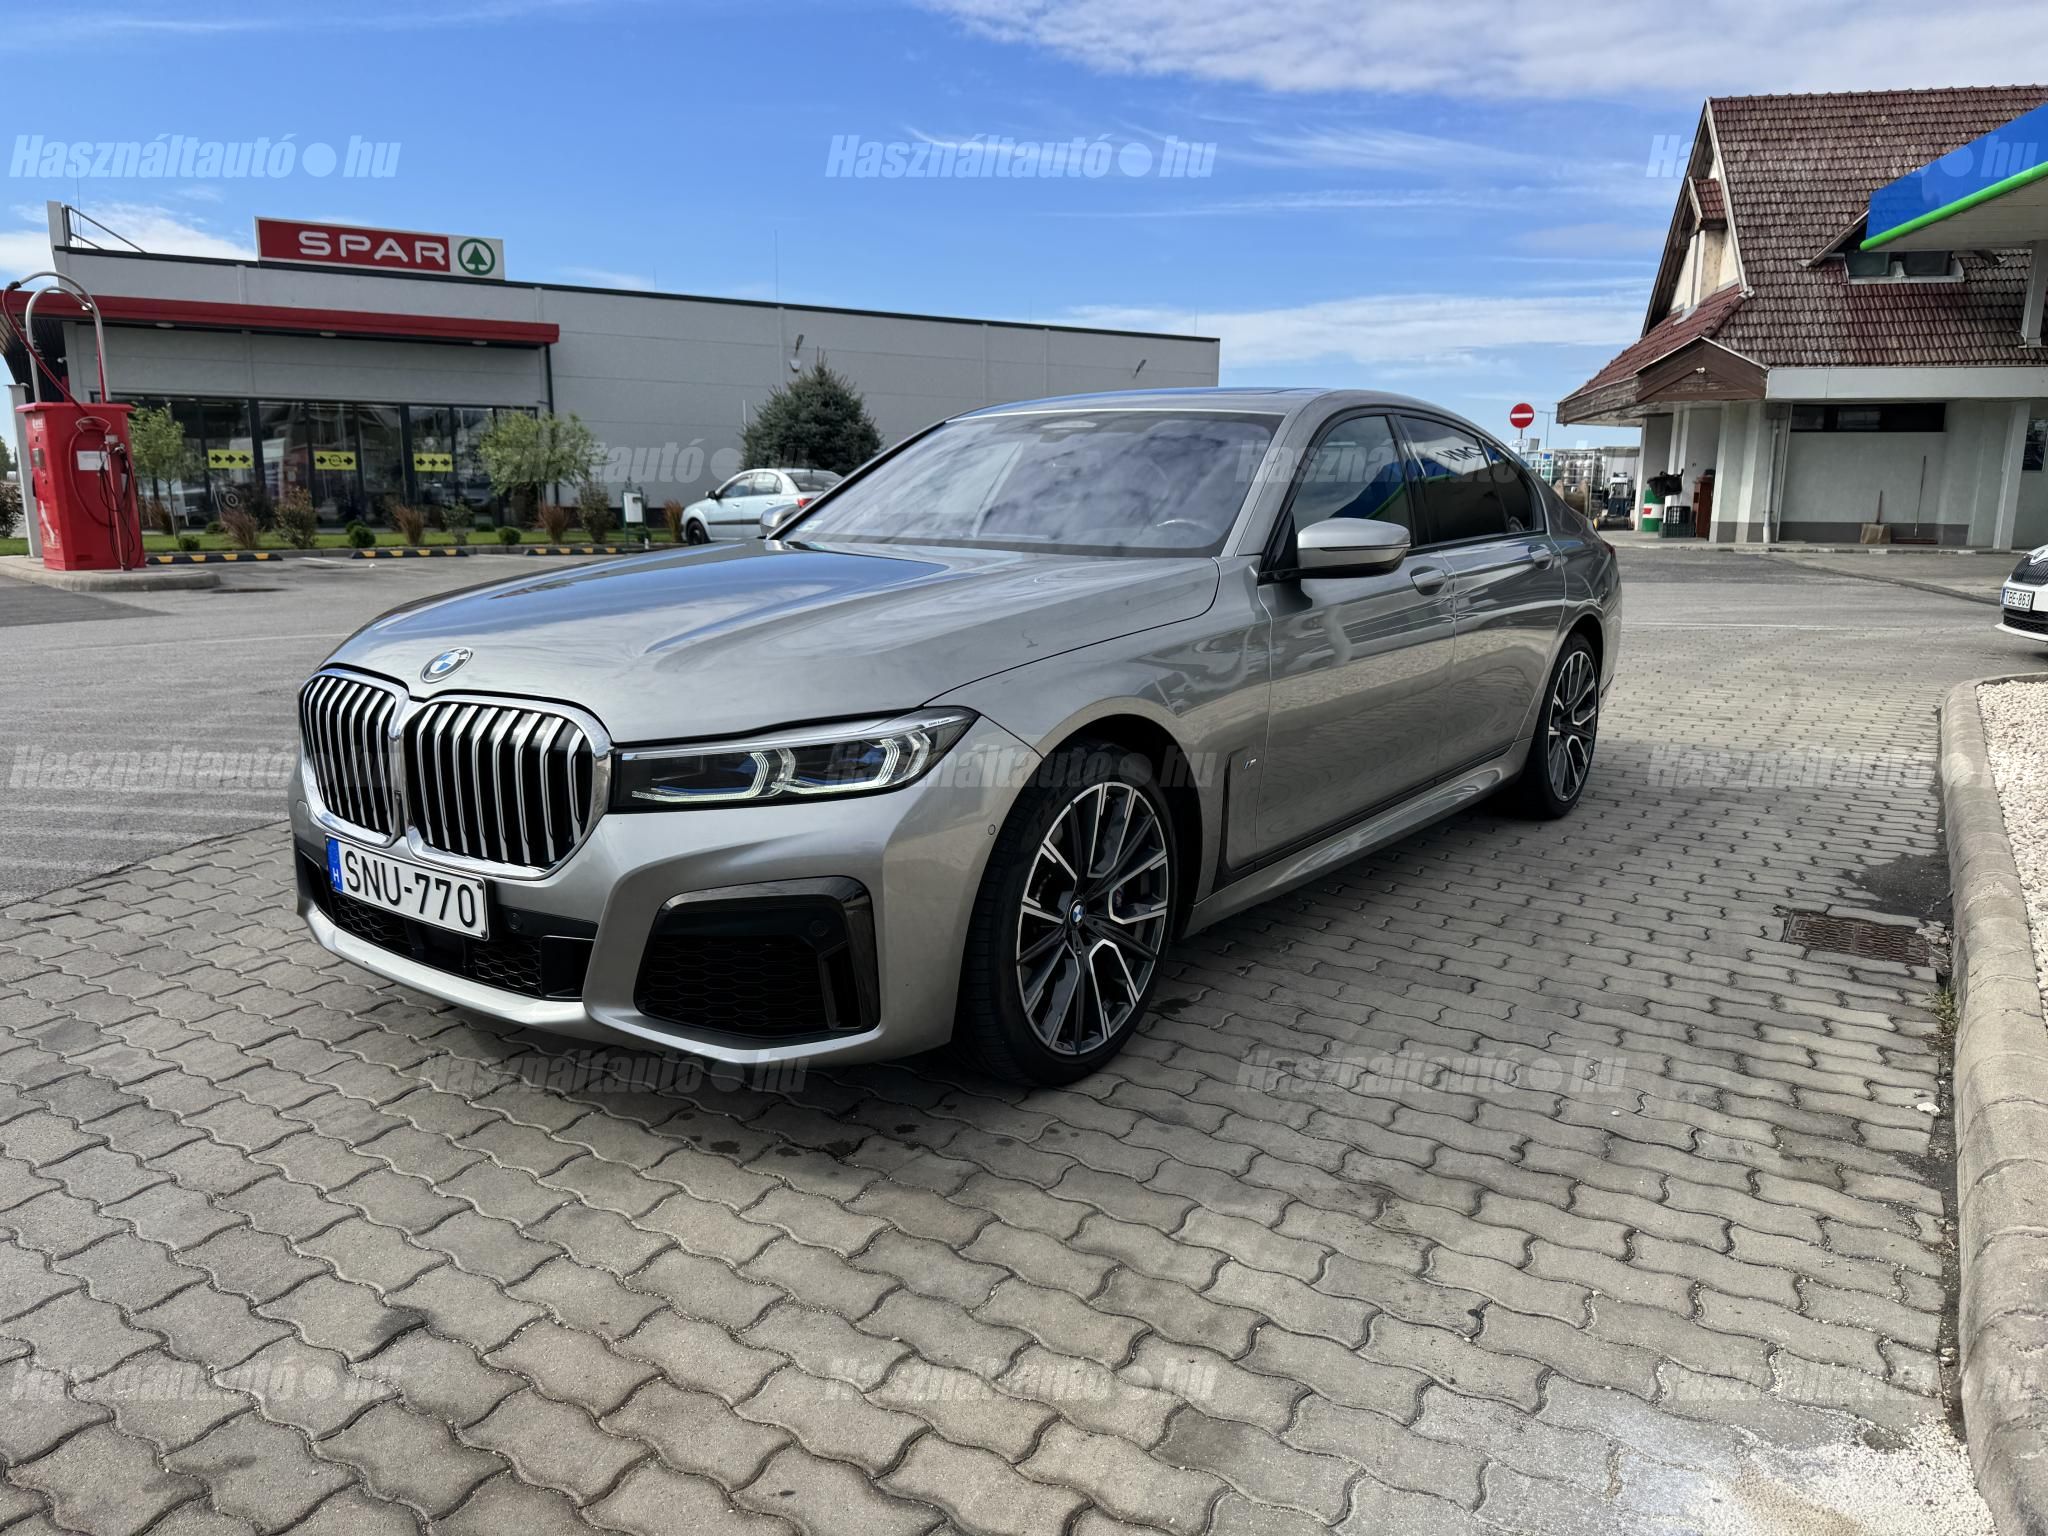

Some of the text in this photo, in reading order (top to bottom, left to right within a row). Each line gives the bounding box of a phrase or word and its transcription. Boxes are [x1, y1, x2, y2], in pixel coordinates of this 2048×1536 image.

[298, 231, 446, 266] SPAR
[332, 868, 340, 883] H
[345, 850, 476, 928] SNU-770
